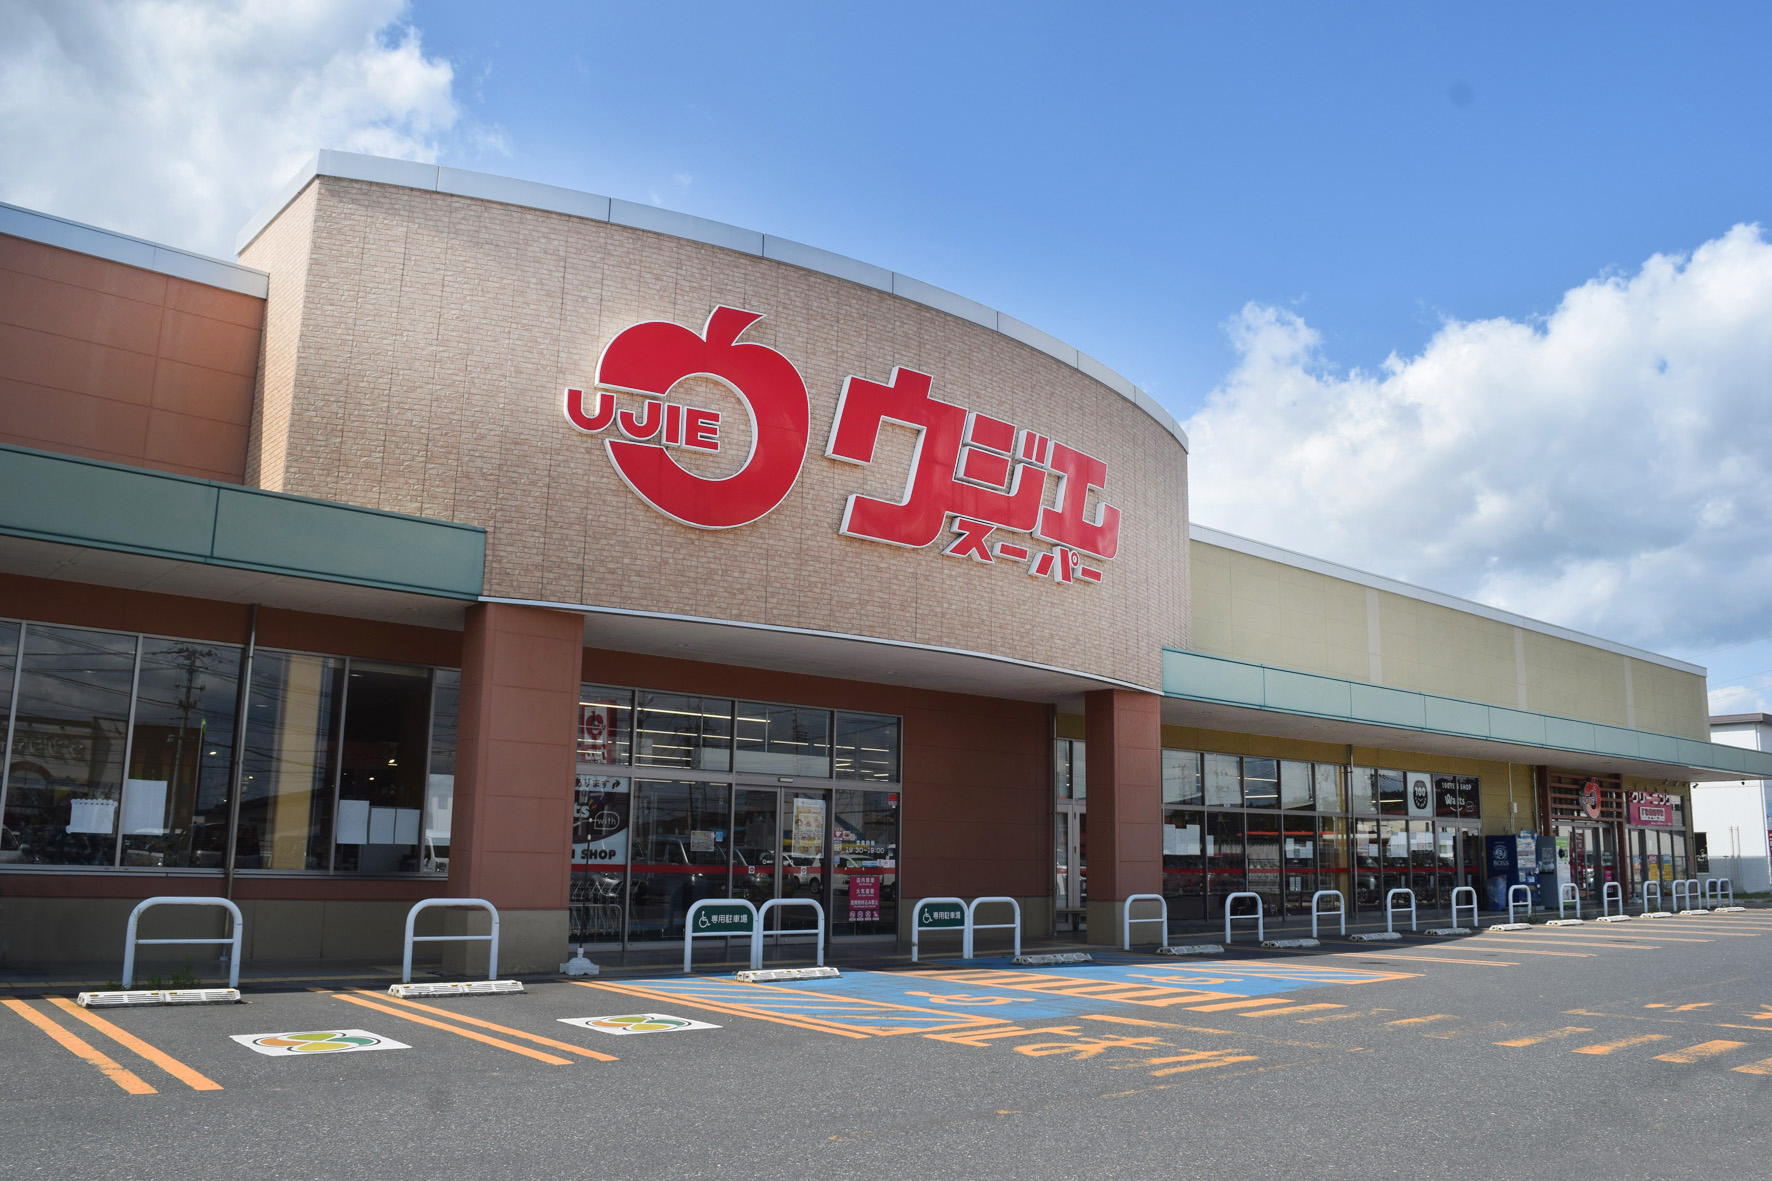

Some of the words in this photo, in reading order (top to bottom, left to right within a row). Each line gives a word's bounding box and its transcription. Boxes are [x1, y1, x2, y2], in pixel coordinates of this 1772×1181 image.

[564, 386, 721, 453] UJIE
[825, 365, 1121, 561] ウジエ
[941, 515, 1104, 584] スーパー
[1414, 786, 1426, 797] 100
[1444, 793, 1466, 806] Wats
[1632, 791, 1671, 806] クリーニング
[597, 816, 617, 825] with
[581, 849, 617, 860] SHOP
[711, 914, 748, 924] 専用駐車場
